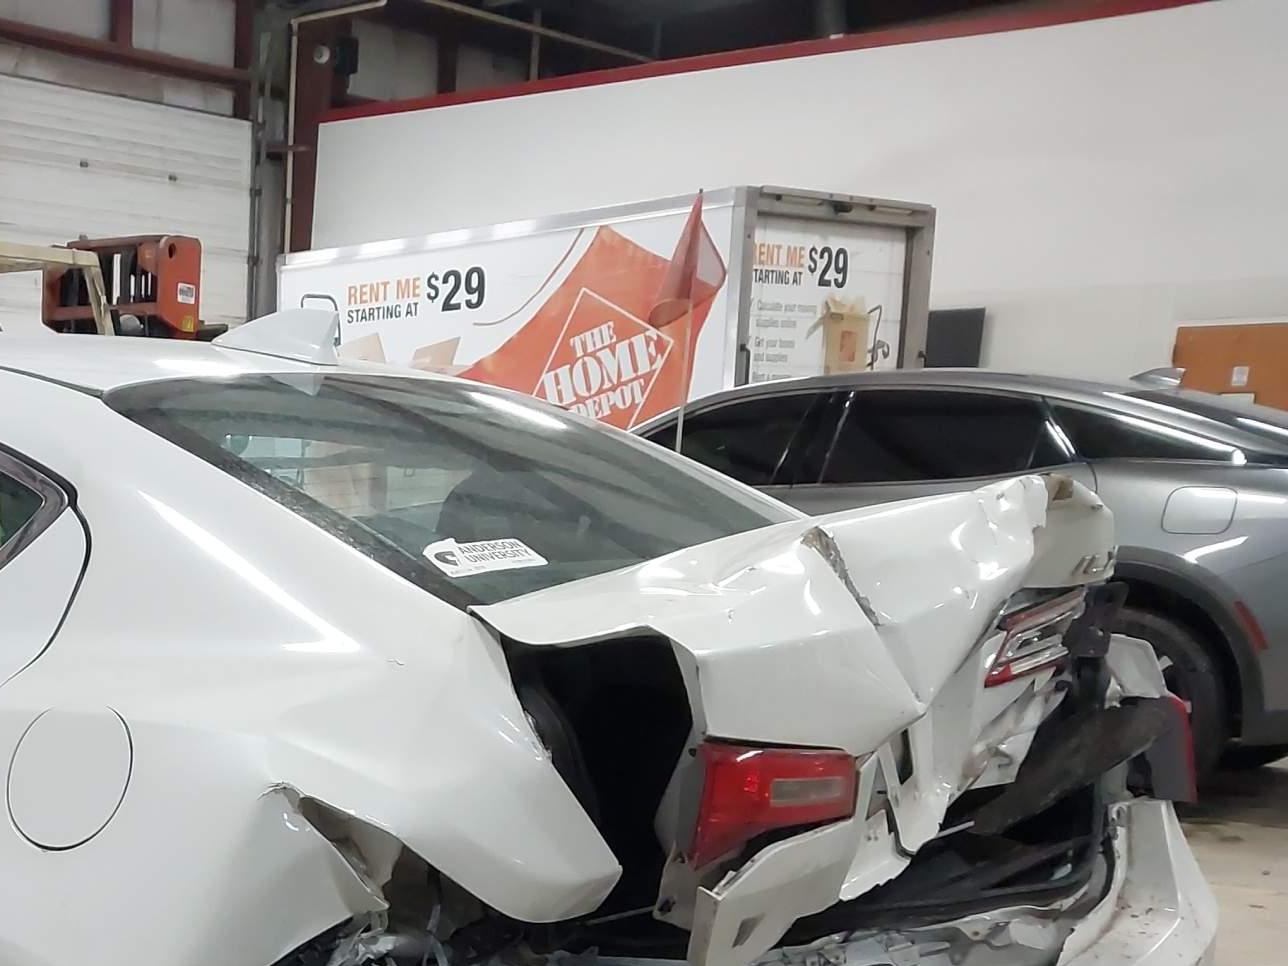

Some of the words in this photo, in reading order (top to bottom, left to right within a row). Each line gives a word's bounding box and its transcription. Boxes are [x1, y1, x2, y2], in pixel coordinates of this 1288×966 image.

[753, 241, 782, 267] ENT
[787, 244, 805, 268] ME
[808, 245, 848, 289] $29
[347, 280, 390, 306] RENT
[396, 277, 421, 300] ME
[426, 266, 486, 312] $29
[753, 269, 790, 286] TARTING
[792, 271, 803, 287] AT
[347, 304, 402, 324] STARTING
[405, 302, 419, 318] AT
[569, 321, 617, 357] THE
[544, 330, 662, 405] HOME
[458, 540, 523, 555] ANDERSON
[464, 549, 532, 563] UNIVERSITY
